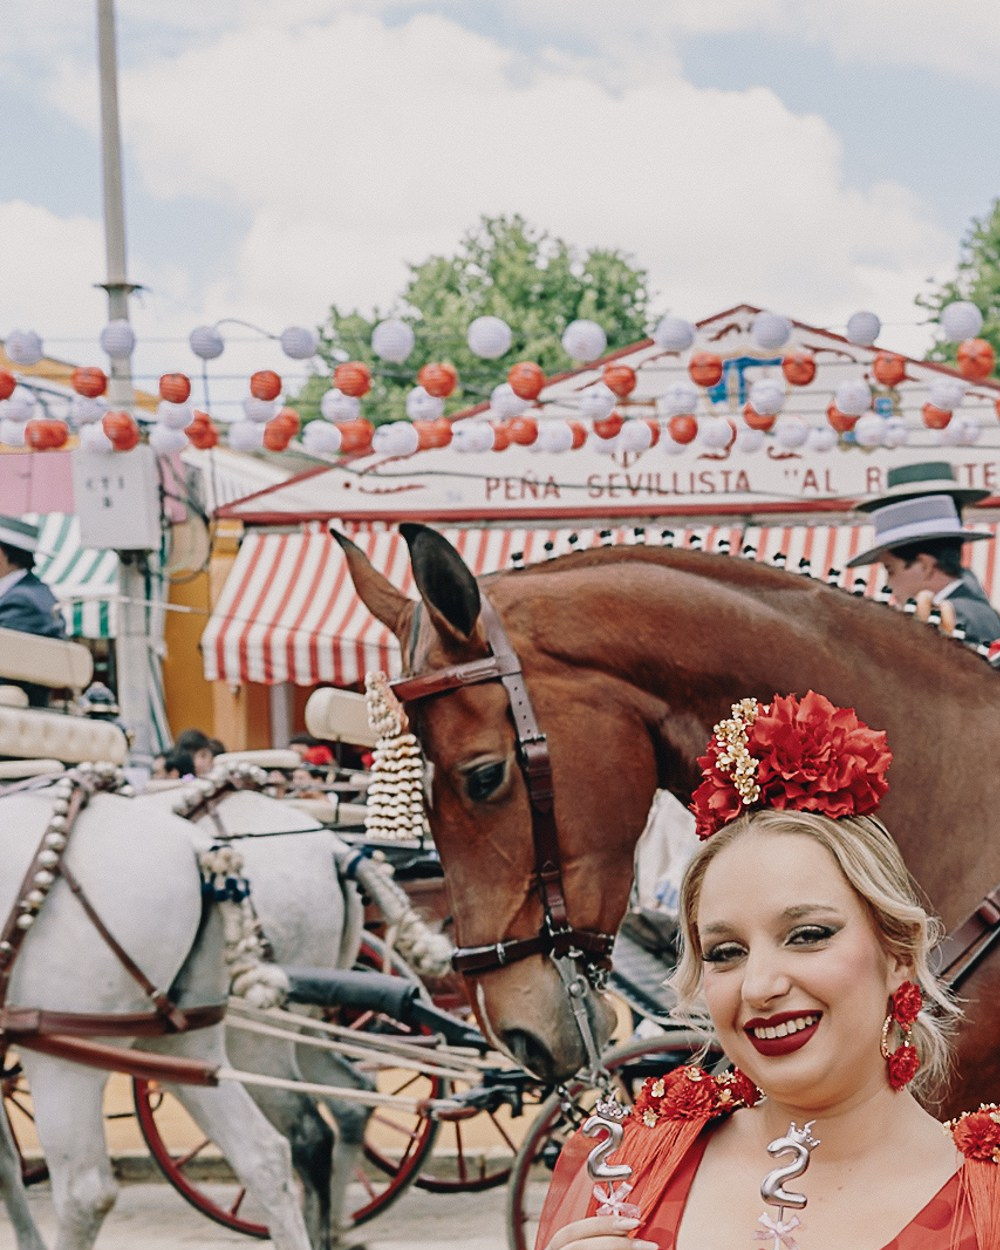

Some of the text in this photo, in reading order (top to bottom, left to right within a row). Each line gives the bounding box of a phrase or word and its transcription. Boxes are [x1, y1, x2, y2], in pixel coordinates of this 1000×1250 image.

[484, 470, 561, 500] PEÑA
[587, 469, 751, 499] SEVILLISTA
[784, 467, 837, 494] "AL
[582, 1115, 633, 1182] 2
[760, 1136, 811, 1209] 2
